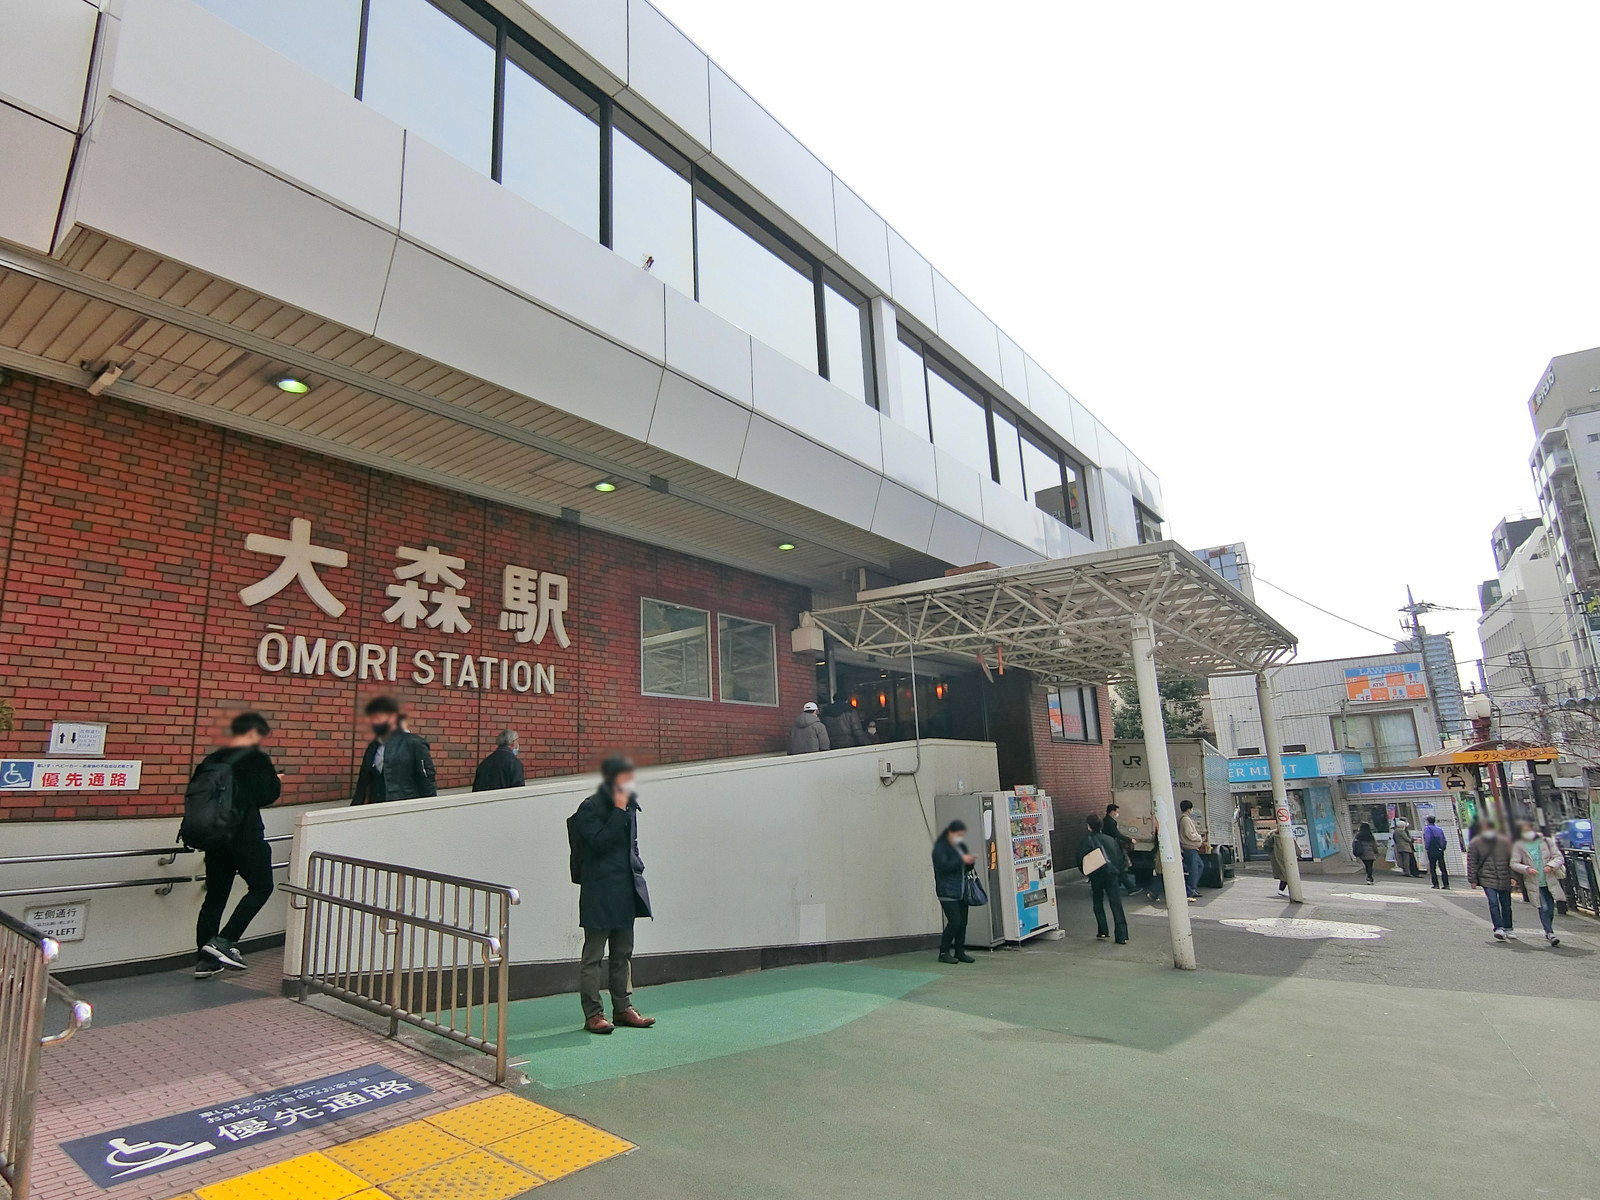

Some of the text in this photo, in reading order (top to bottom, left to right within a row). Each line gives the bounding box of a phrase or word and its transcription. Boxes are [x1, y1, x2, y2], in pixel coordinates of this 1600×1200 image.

[237, 517, 571, 649] 大森駅
[257, 624, 555, 694] ŌMORI STATION
[1359, 664, 1405, 675] LAWSON
[1122, 755, 1141, 766] JR
[1249, 764, 1297, 776] MIIT
[1438, 766, 1467, 774] TAXI
[41, 772, 128, 787] 優先通路
[1369, 780, 1437, 793] LAWSON
[33, 908, 77, 920] 左側通行
[56, 927, 77, 936] LEFT
[218, 1078, 414, 1142] 優先通路
